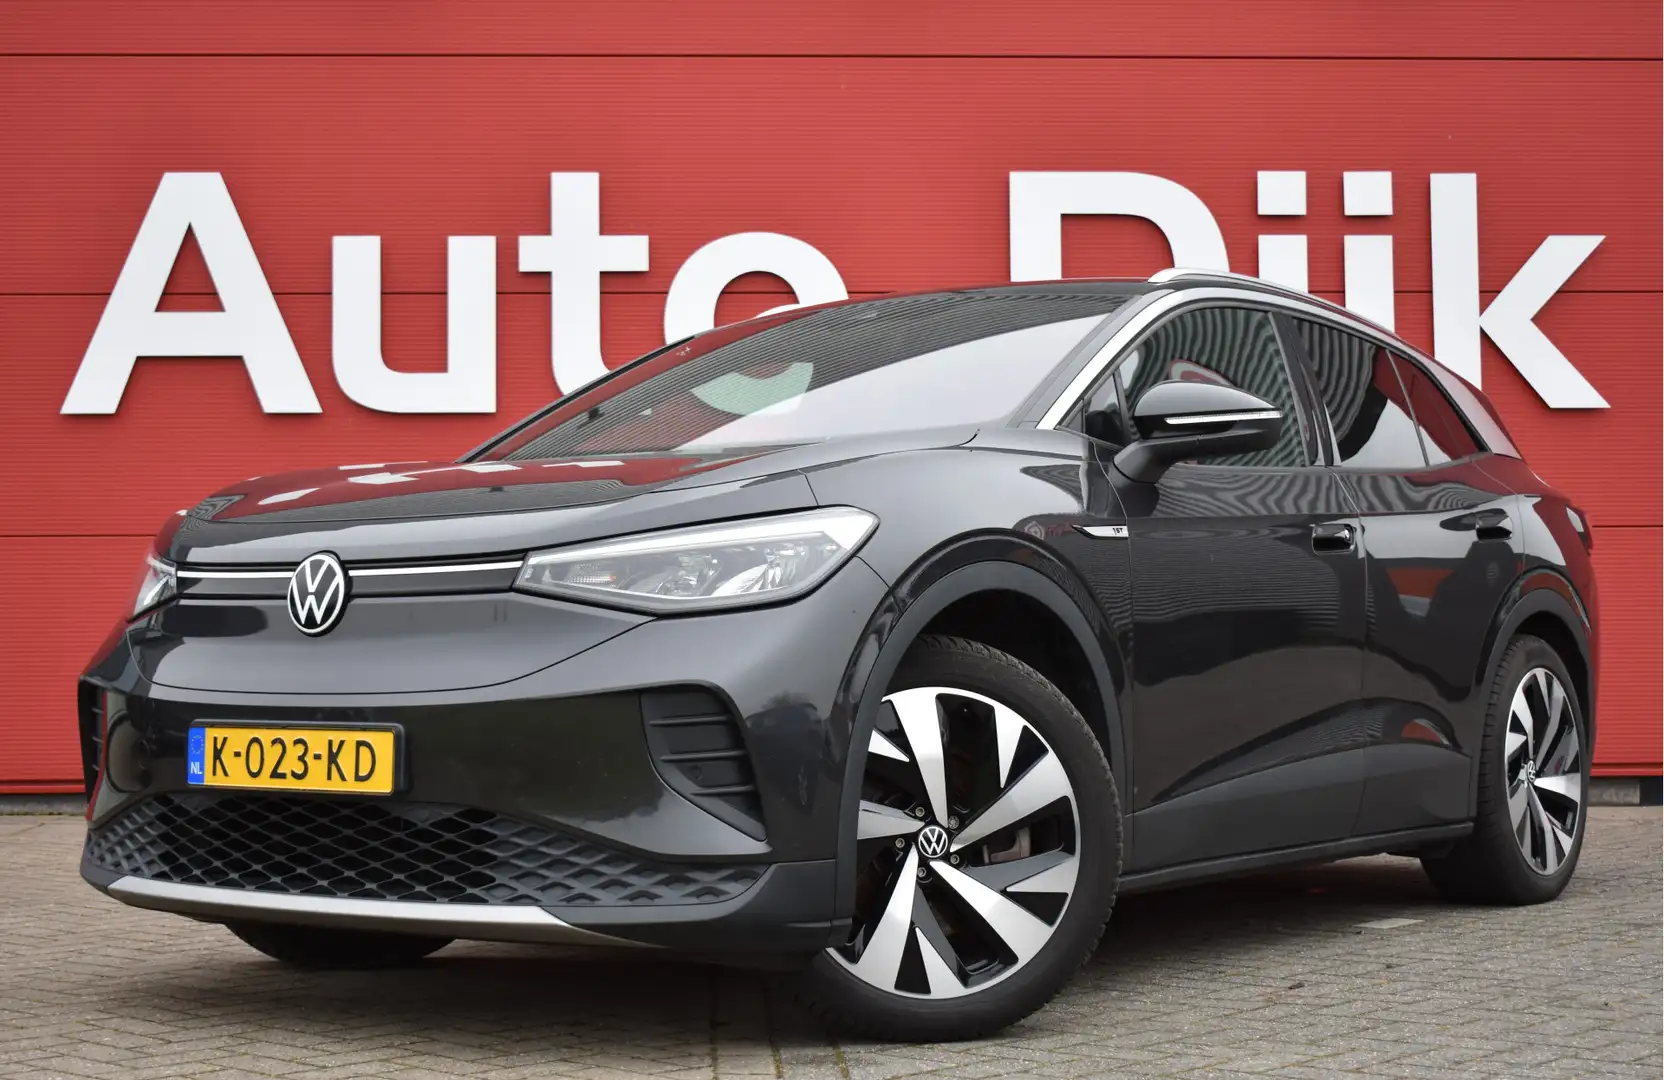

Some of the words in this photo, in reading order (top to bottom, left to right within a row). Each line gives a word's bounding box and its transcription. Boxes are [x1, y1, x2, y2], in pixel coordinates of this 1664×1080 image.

[60, 171, 849, 415] Auto
[289, 556, 343, 630] VW
[190, 762, 203, 775] NL
[211, 735, 377, 783] K-023-KD
[918, 826, 949, 858] VW
